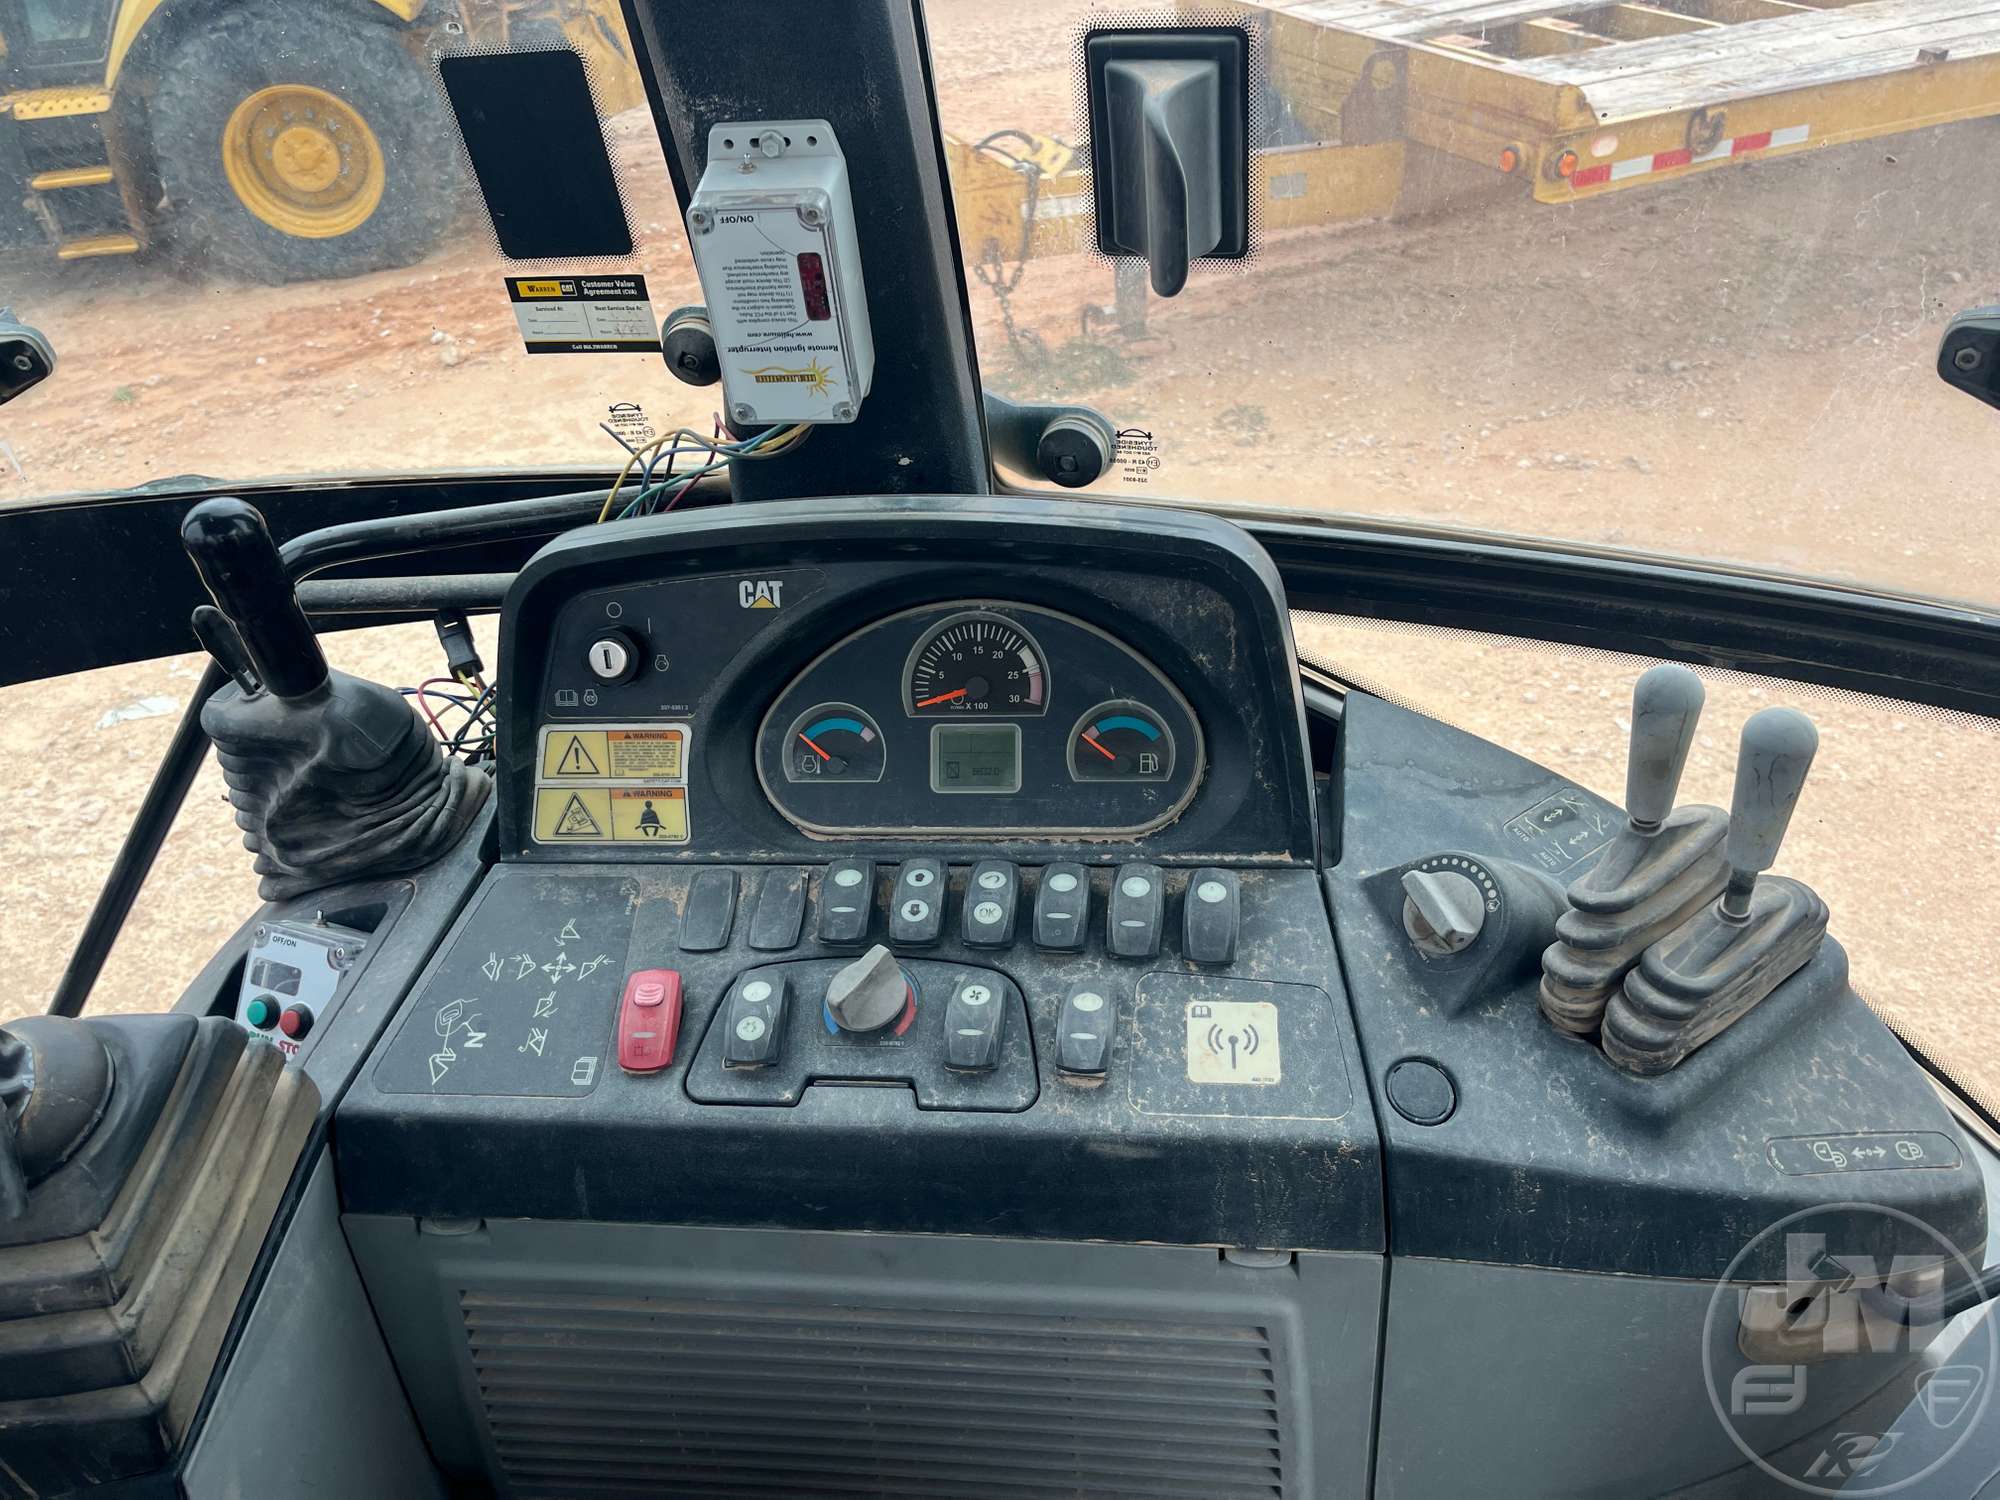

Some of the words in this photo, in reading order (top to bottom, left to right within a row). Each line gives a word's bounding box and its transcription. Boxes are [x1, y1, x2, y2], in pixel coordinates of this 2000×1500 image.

[719, 215, 754, 224] ON/OFF
[581, 280, 613, 288] Customer
[614, 280, 636, 288] Value
[583, 287, 622, 297] Agreement
[728, 345, 772, 354] Interrupter
[774, 344, 806, 353] Ignition
[738, 580, 784, 609] CAT
[972, 646, 985, 655] 15
[992, 650, 1004, 660] 20
[952, 652, 963, 661] 10
[938, 671, 945, 679] 5
[1007, 671, 1020, 680] 25
[1008, 694, 1020, 703] 30
[965, 702, 972, 710] X
[973, 702, 989, 710] 100
[632, 790, 673, 798] WARNING
[1512, 827, 1530, 842] AUTO
[1539, 851, 1557, 866] AUTO
[272, 935, 297, 948] OFF/ON
